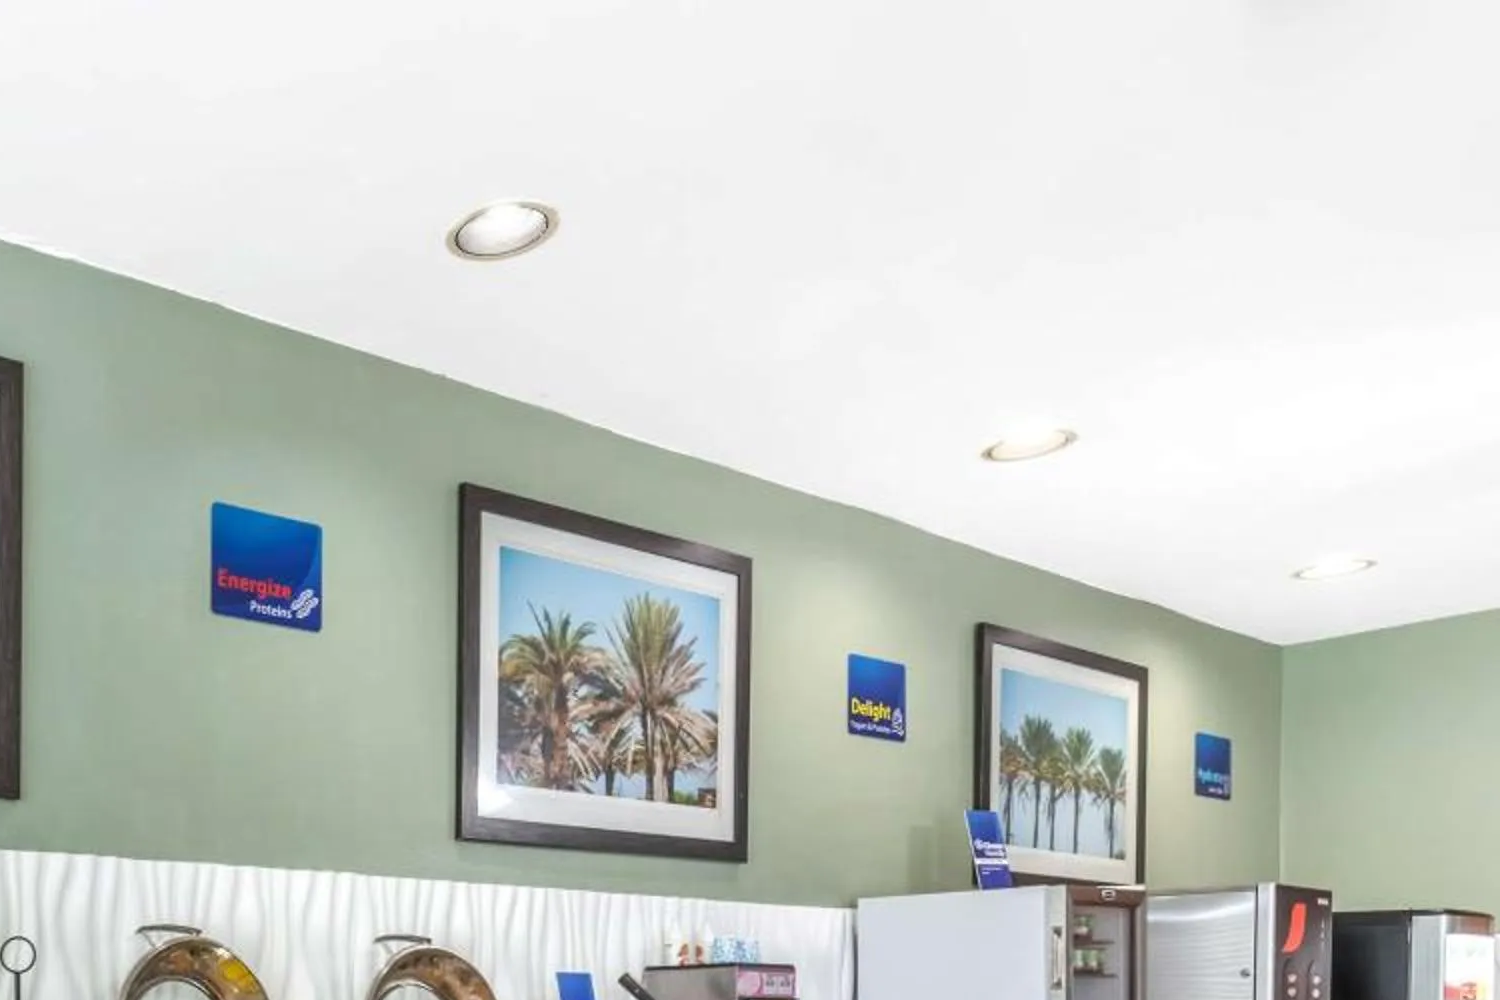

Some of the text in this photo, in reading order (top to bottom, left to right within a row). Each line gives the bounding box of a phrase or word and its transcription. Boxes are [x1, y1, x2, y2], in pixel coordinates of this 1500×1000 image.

[217, 567, 293, 600] Energize
[249, 600, 293, 619] Proteins
[851, 697, 892, 722] Delight
